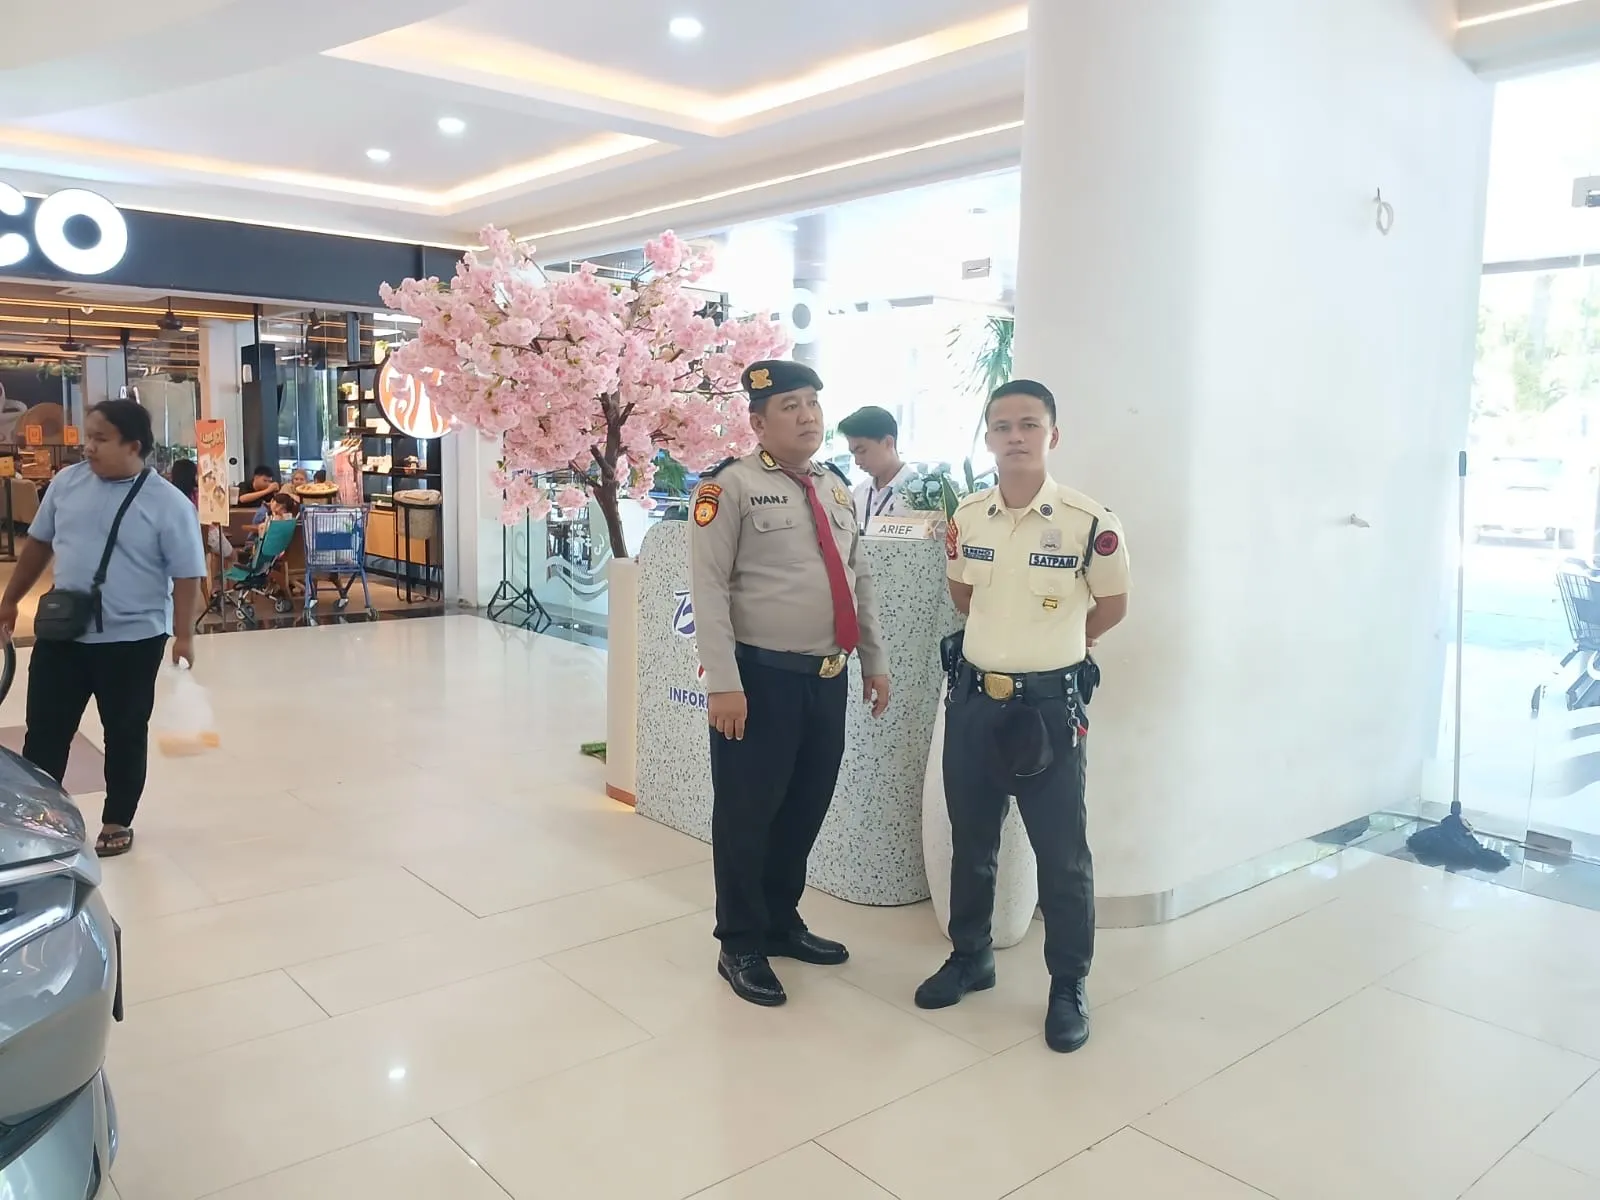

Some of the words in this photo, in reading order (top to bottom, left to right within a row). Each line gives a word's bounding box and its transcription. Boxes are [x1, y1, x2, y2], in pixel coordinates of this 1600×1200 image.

[750, 495, 789, 506] IVAN.F
[879, 524, 913, 535] ARIEF
[1033, 555, 1074, 567] SATPAM
[669, 687, 708, 709] INFOR
